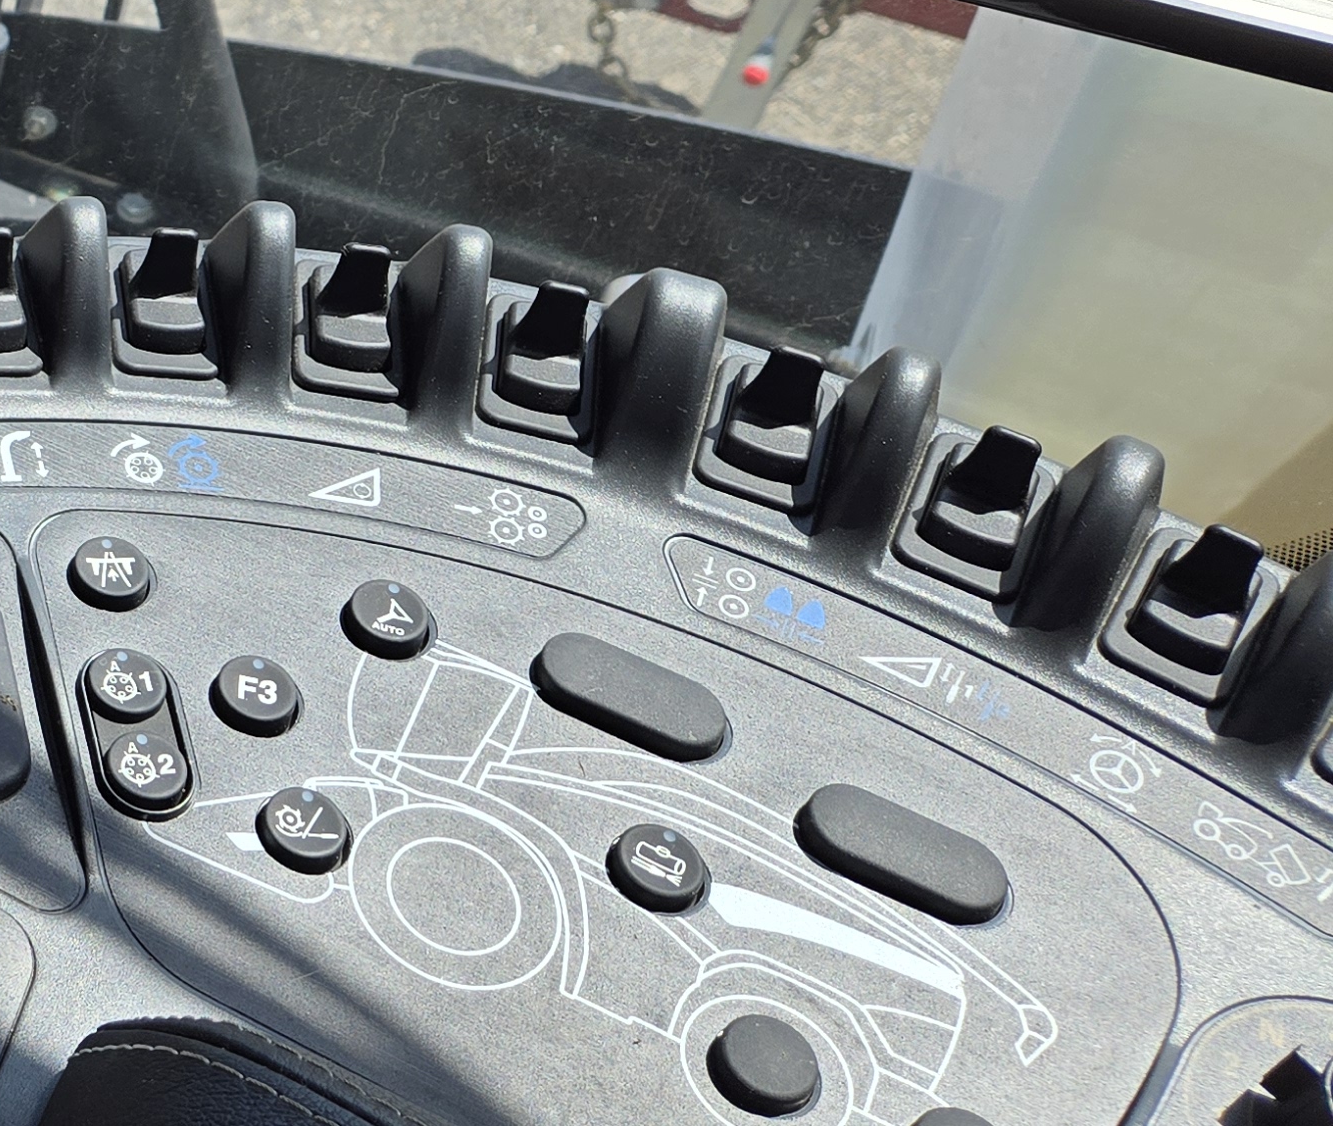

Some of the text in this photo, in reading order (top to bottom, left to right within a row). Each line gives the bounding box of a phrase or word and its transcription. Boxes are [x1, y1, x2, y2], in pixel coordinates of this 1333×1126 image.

[372, 620, 405, 635] AUTO
[138, 671, 153, 692] 1
[237, 674, 278, 705] F3
[157, 754, 176, 775] 2
